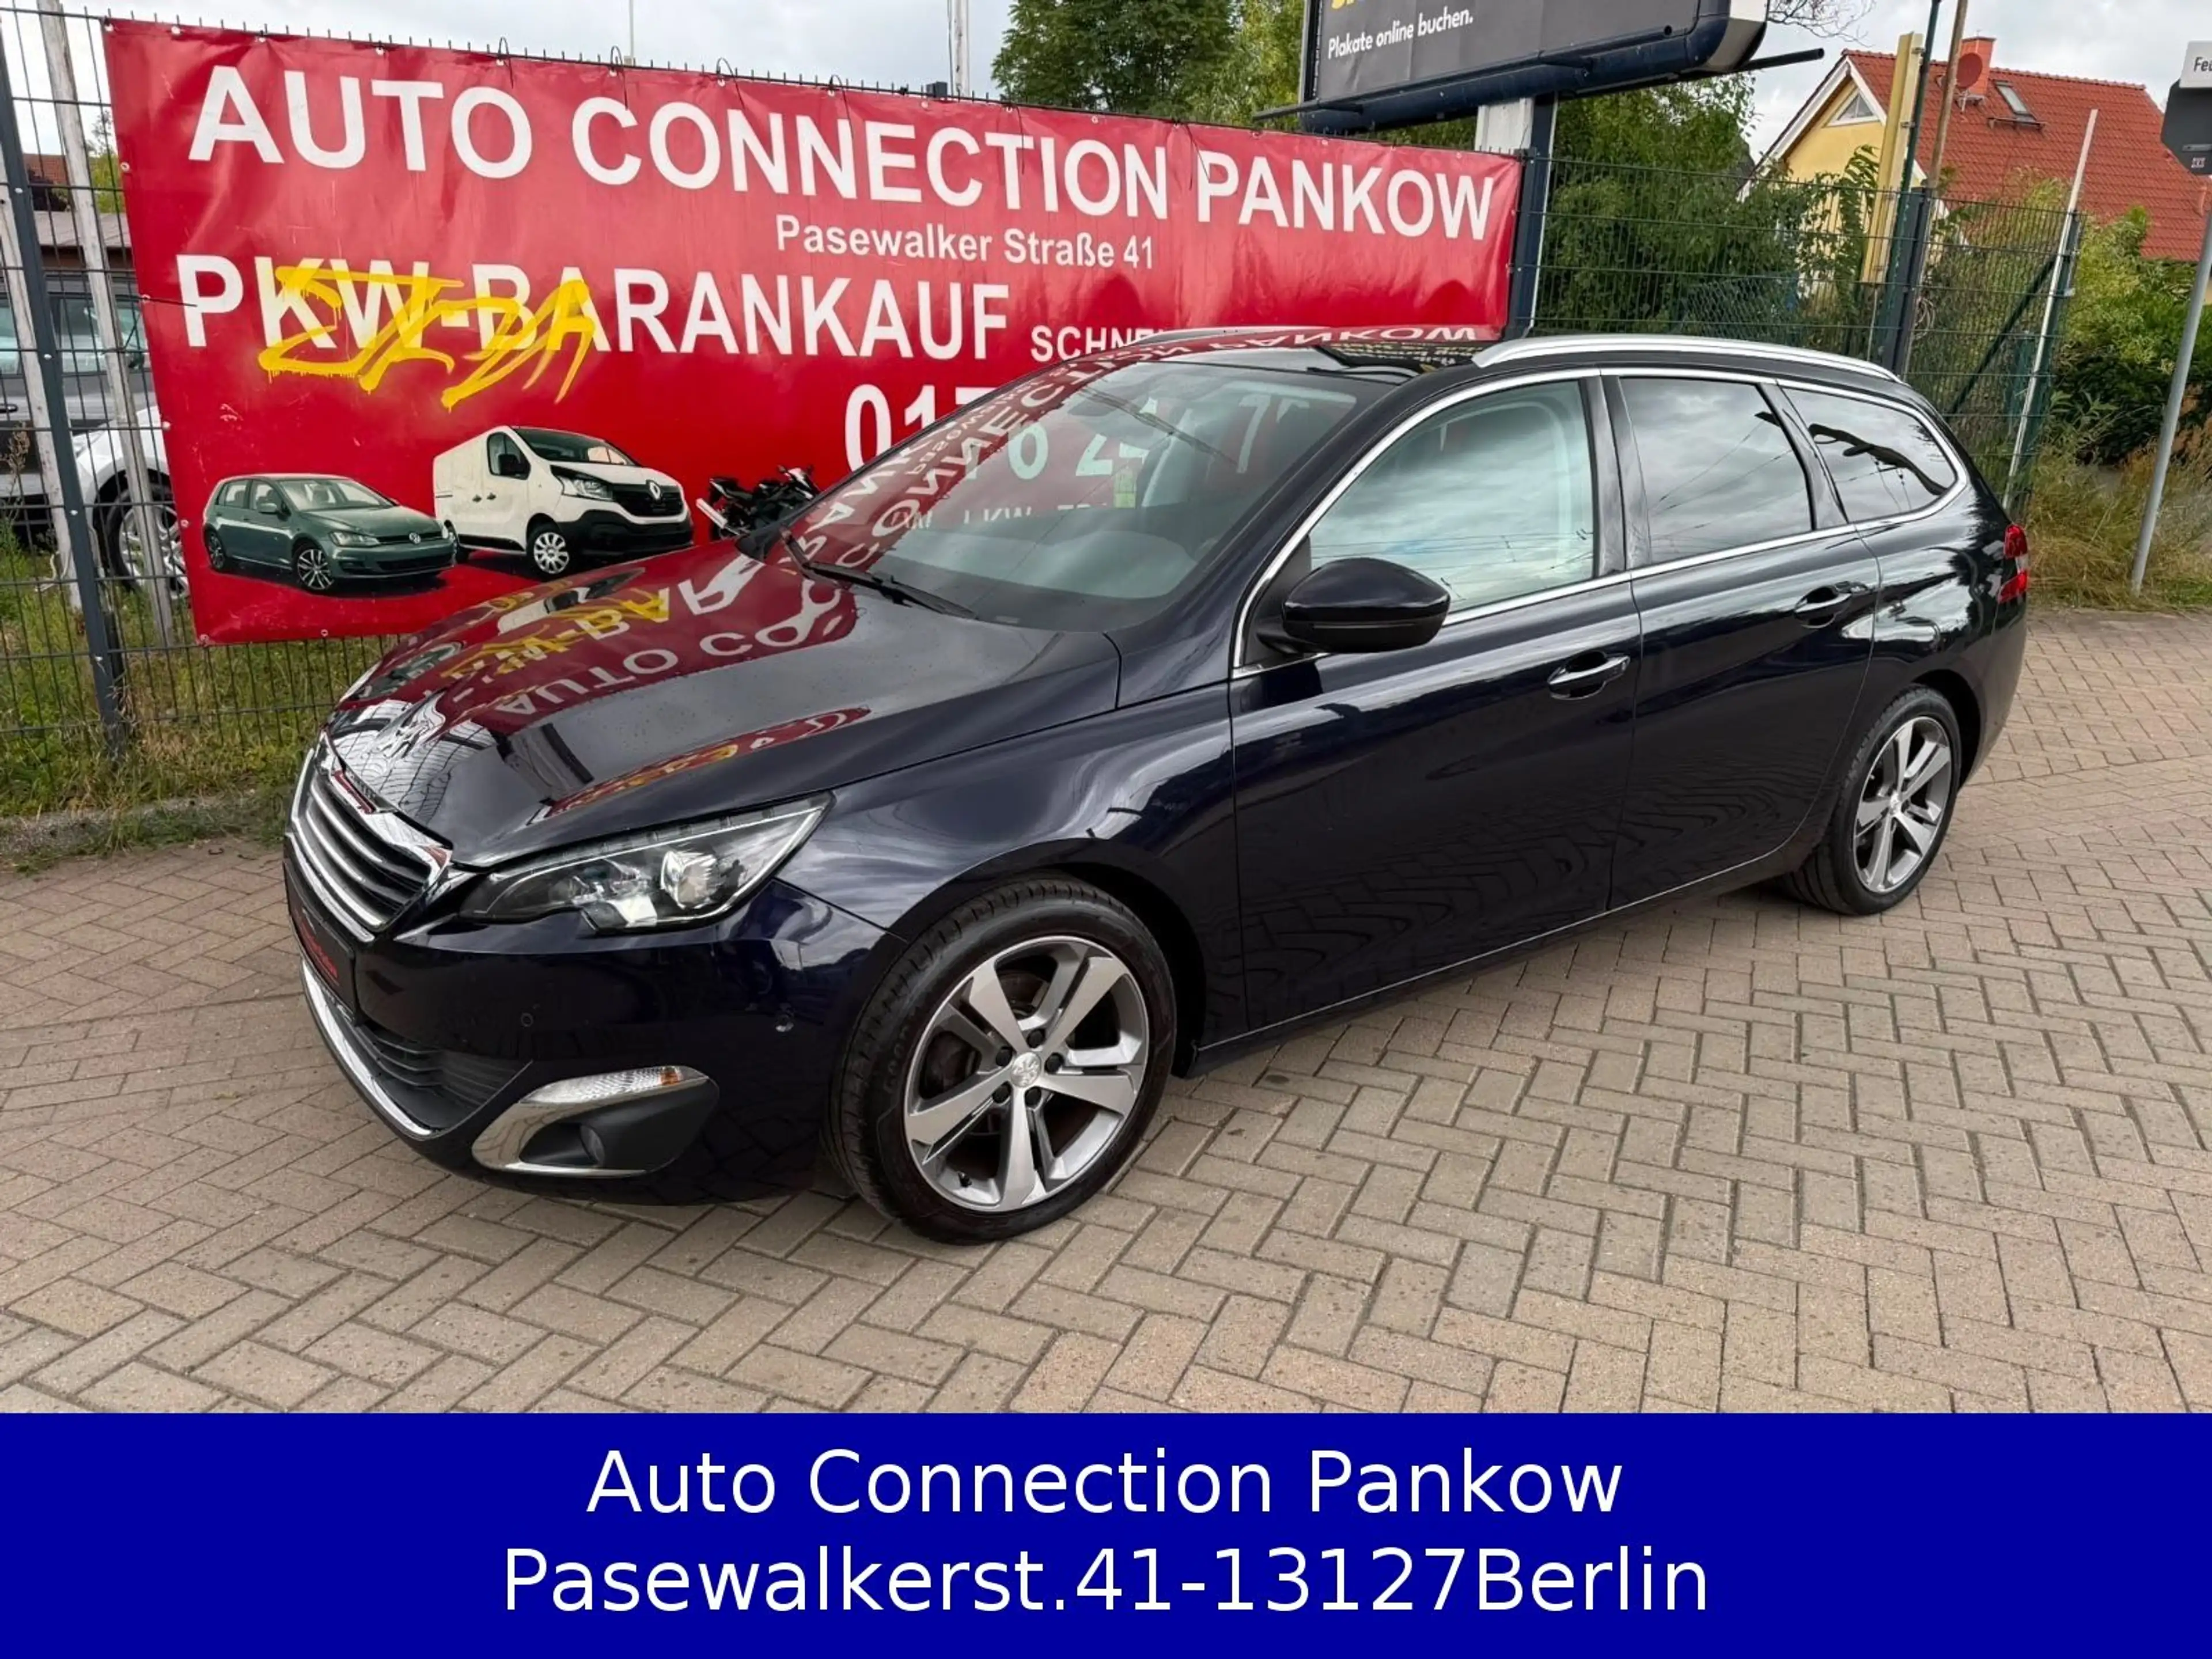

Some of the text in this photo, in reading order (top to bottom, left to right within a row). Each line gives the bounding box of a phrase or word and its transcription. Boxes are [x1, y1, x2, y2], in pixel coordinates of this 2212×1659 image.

[1328, 6, 1474, 59] Plakate online buchen.
[190, 66, 1494, 240] AUTO CONNECTION PANKOW
[777, 214, 1153, 269] Pasewalker Straße 41
[177, 255, 1009, 359] PKW-BARANKAUF
